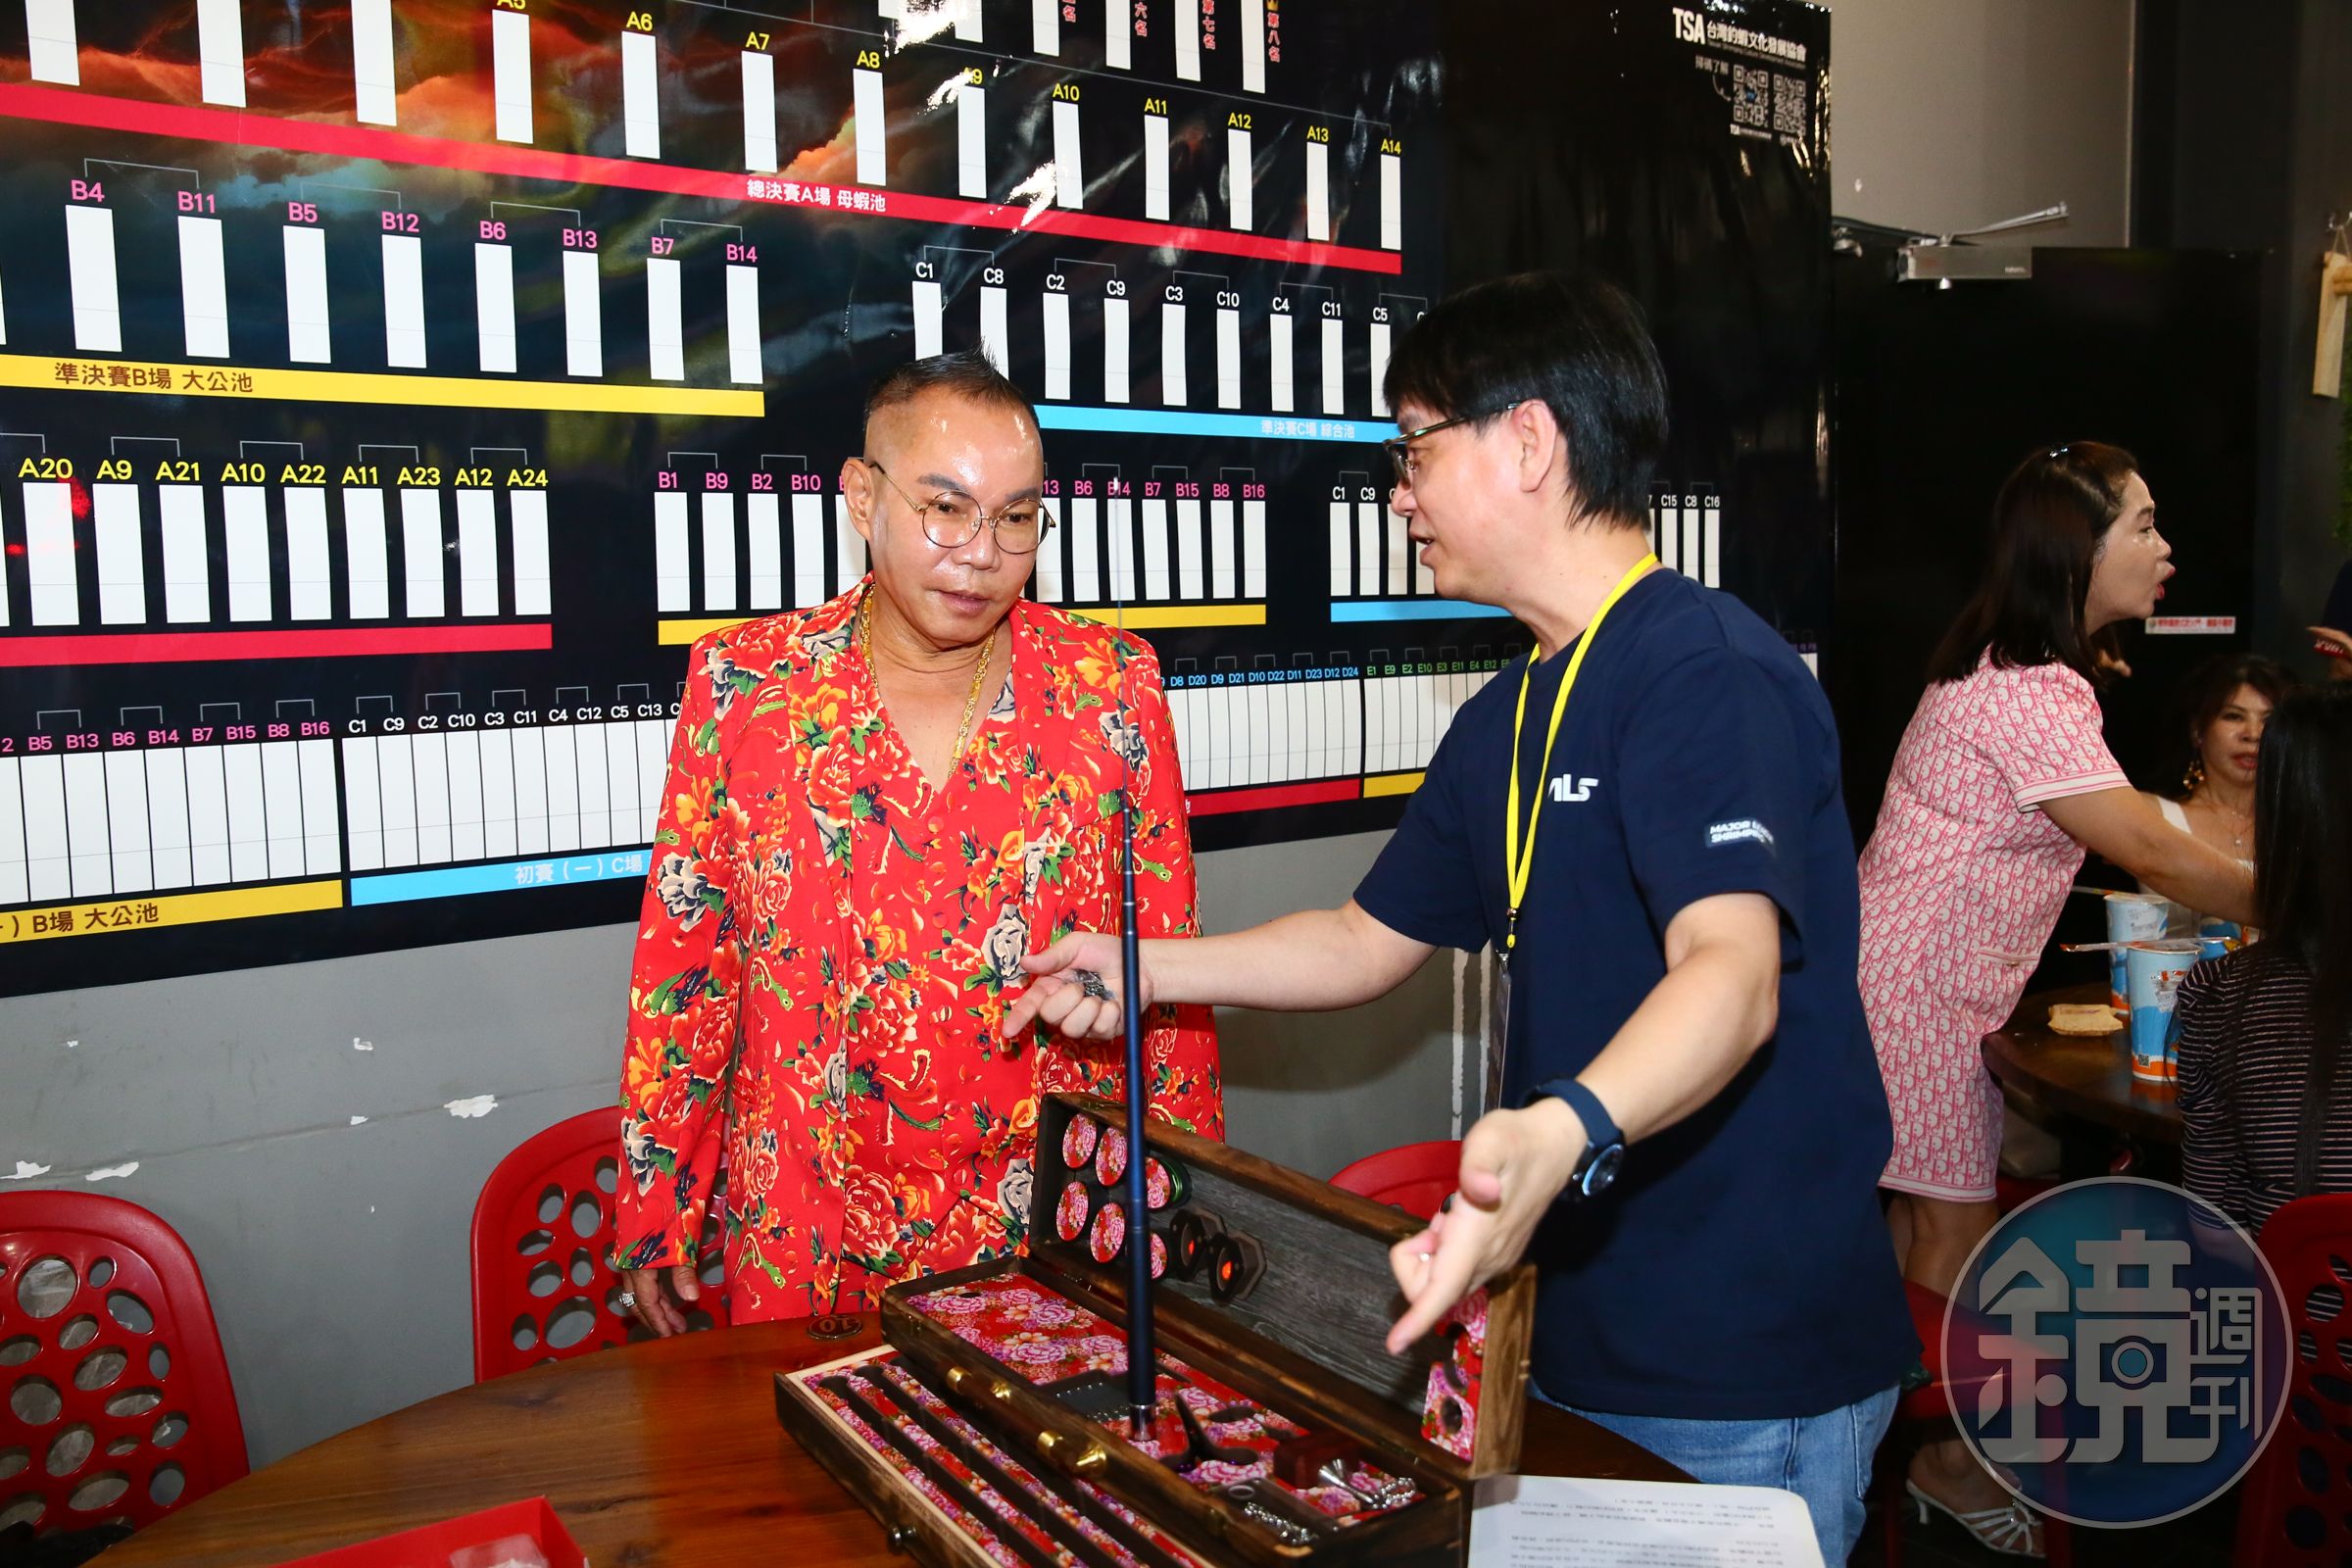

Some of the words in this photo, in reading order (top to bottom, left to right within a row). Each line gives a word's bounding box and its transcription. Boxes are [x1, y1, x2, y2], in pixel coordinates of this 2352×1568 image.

[1062, 0, 1076, 23] 名
[1267, 12, 1281, 63] 第八名
[1673, 8, 1705, 45] TSA
[626, 12, 653, 31] A6
[746, 32, 769, 50] A7
[857, 51, 879, 68] A8
[1053, 83, 1079, 101] A10
[1145, 98, 1166, 114] A11
[1228, 113, 1250, 128] A12
[1307, 126, 1328, 141] A13
[1381, 139, 1400, 154] A14
[747, 179, 831, 207] 總決賽A場
[836, 190, 887, 212] 母蝦池
[72, 180, 104, 202] B4
[178, 191, 215, 213] B11
[288, 202, 318, 222] B5
[382, 212, 418, 232] B12
[480, 220, 506, 240] B6
[564, 228, 597, 248] B13
[652, 237, 674, 254] B7
[727, 244, 757, 262] B14
[916, 262, 933, 278] C1
[984, 268, 1004, 284] C8
[1047, 274, 1064, 290] C2
[1107, 280, 1125, 296] C9
[1166, 286, 1183, 301] C3
[1217, 291, 1239, 307] C10
[1273, 297, 1290, 312] C4
[1322, 302, 1340, 317] C11
[1373, 307, 1388, 321] C5
[54, 363, 171, 390] 準決賽B場
[183, 369, 253, 394] 大公池
[19, 459, 73, 478] A20
[97, 461, 131, 479] A9
[156, 462, 199, 480] A21
[221, 464, 265, 482] A10
[280, 465, 325, 483] A22
[342, 466, 377, 484] A11
[398, 467, 440, 485] A23
[455, 468, 493, 486] A12
[507, 469, 548, 486] A24
[659, 471, 676, 488] B1
[707, 472, 728, 489] B9
[753, 473, 772, 489] B2
[792, 474, 820, 490] B10
[1043, 480, 1059, 495] 13
[1075, 481, 1092, 495] B6
[1108, 481, 1130, 495] B14
[1146, 482, 1160, 496] B7
[1176, 483, 1199, 497] B15
[1213, 484, 1229, 497] B8
[1244, 484, 1264, 498] B16
[1333, 486, 1345, 500] C1
[1361, 487, 1375, 500] C9
[1661, 495, 1677, 507] C15
[1686, 496, 1696, 507] C8
[1705, 496, 1719, 507] C16
[1170, 676, 1184, 686] D8
[1189, 675, 1206, 685] D20
[1211, 674, 1224, 684] D9
[1229, 673, 1244, 683] D21
[1249, 672, 1265, 682] D10
[1268, 670, 1285, 681] D22
[1288, 670, 1300, 679] D11
[1305, 668, 1322, 679] D23
[1325, 668, 1340, 677] D12
[1343, 667, 1358, 676] D24
[1367, 665, 1376, 675] E1
[1385, 664, 1395, 674] E9
[1402, 664, 1413, 673] E2
[1417, 662, 1432, 673] E10
[1437, 662, 1447, 672] E3
[1451, 662, 1464, 671] E11
[1470, 661, 1480, 670] E4
[1484, 660, 1496, 669] E12
[349, 719, 366, 733] C1
[383, 717, 405, 731] C9
[418, 715, 438, 729] C2
[448, 713, 475, 727] C10
[484, 712, 505, 725] C3
[514, 710, 536, 723] C11
[549, 710, 568, 721] C4
[577, 707, 602, 720] C12
[611, 706, 629, 718] C5
[638, 704, 662, 716] C13
[670, 703, 679, 715] C
[28, 736, 52, 751] B5
[67, 734, 98, 748] B13
[113, 732, 135, 746] B6
[149, 730, 179, 744] B14
[192, 728, 213, 742] B7
[226, 726, 256, 740] B15
[269, 724, 289, 737] B8
[301, 721, 329, 735] B16
[1710, 820, 1751, 834] MAJOR
[84, 903, 159, 929] 大公池
